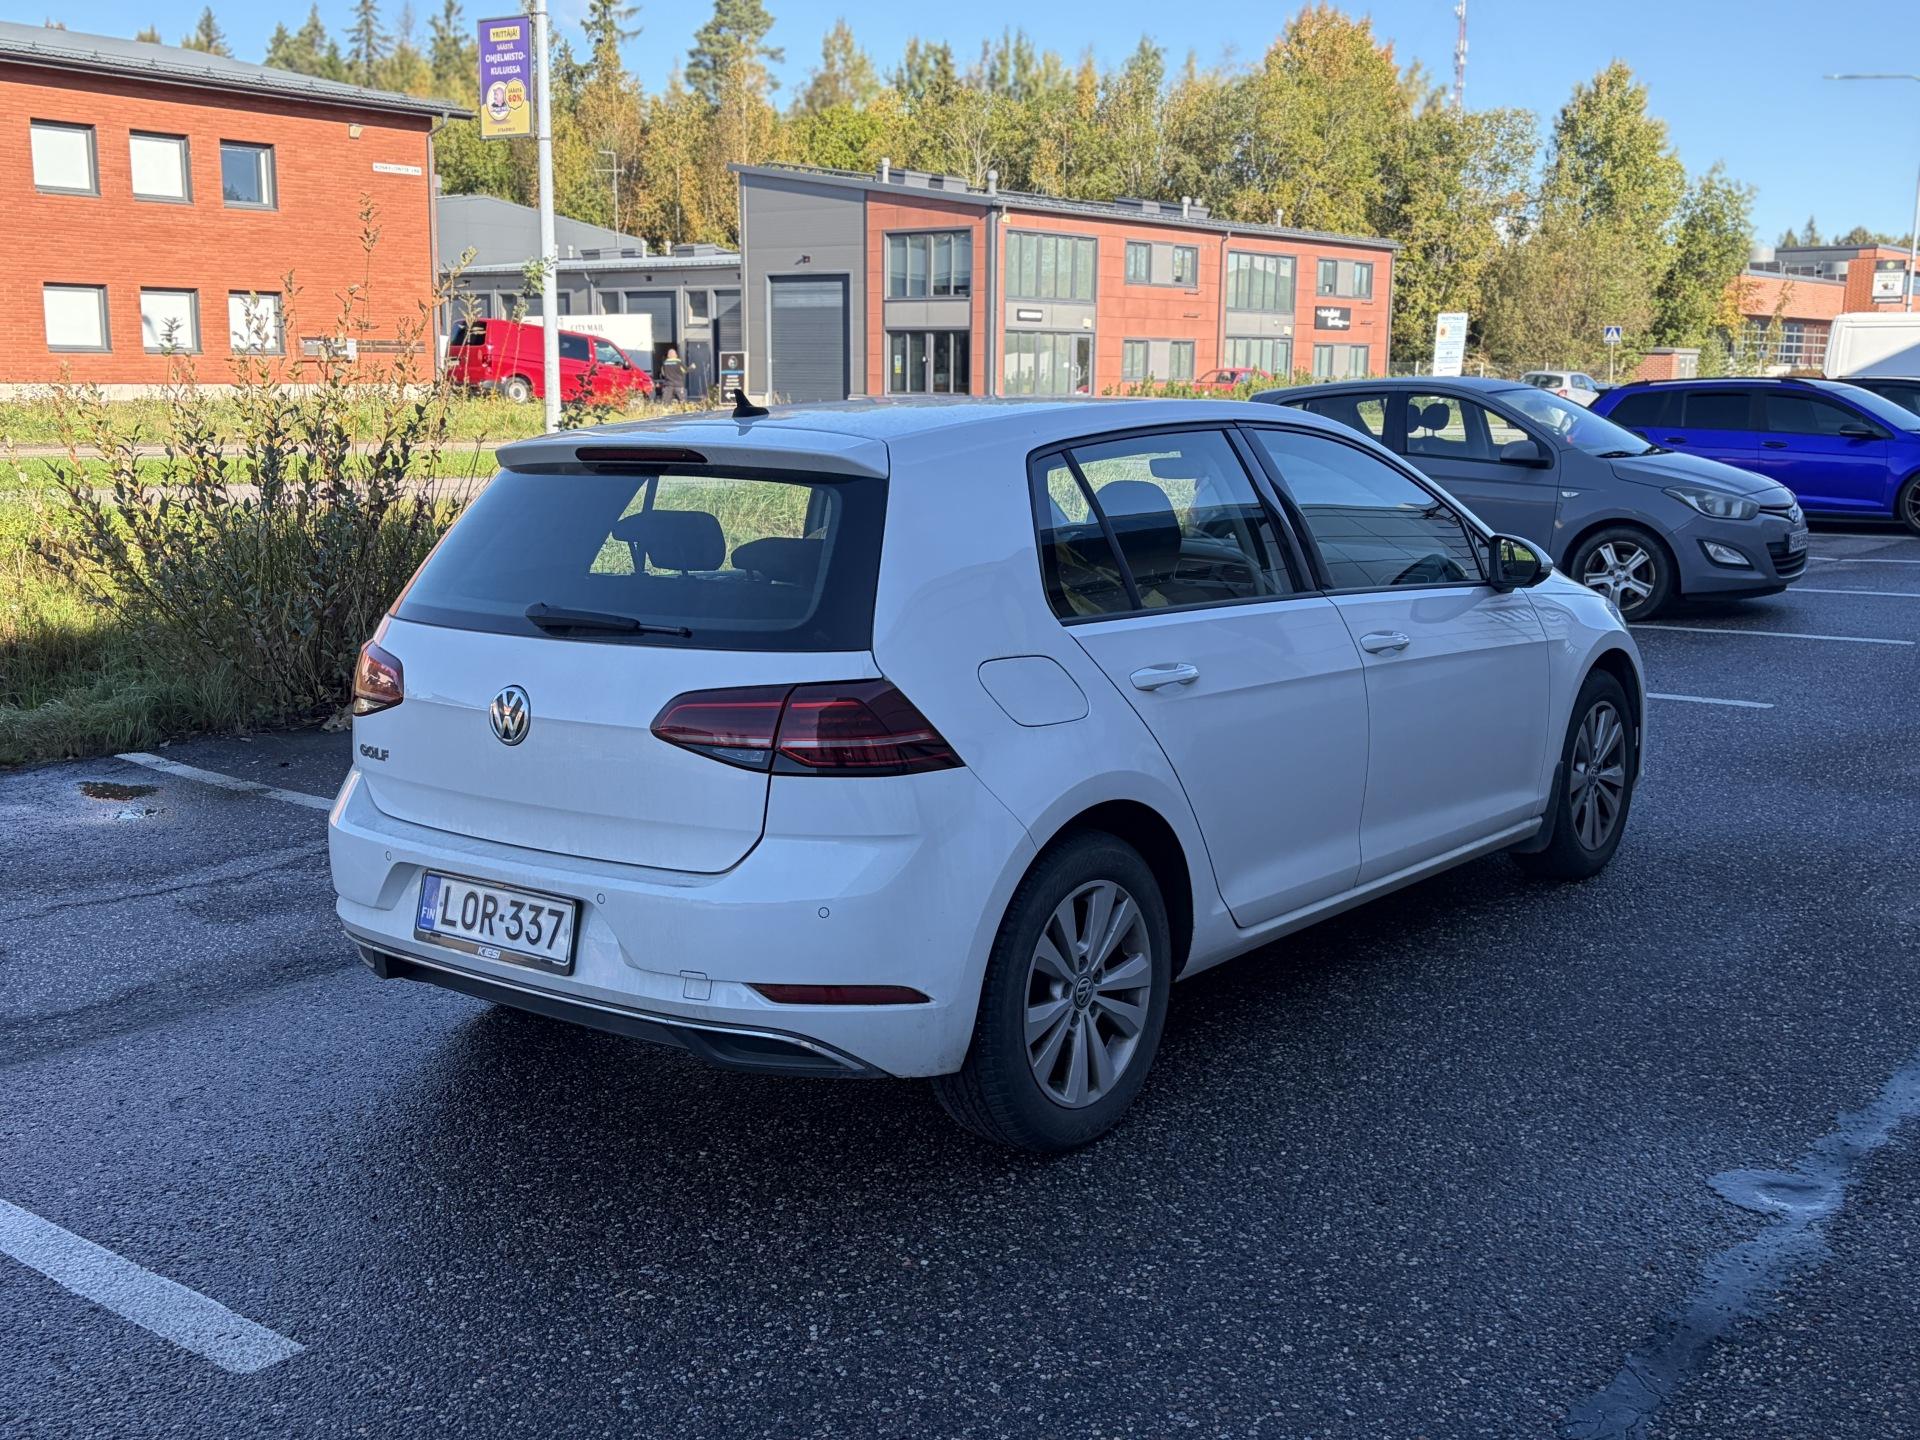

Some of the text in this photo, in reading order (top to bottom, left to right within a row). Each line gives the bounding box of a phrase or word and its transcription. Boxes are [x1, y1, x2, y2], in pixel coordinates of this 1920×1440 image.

[492, 28, 518, 39] YRITTÄJÄ!
[485, 51, 526, 64] OHJELMISTO-
[490, 65, 521, 75] KULUISSA
[508, 94, 522, 102] 60%
[359, 743, 390, 761] GOLF
[421, 886, 565, 949] FIN LOR-337
[477, 946, 501, 960] KIESI
